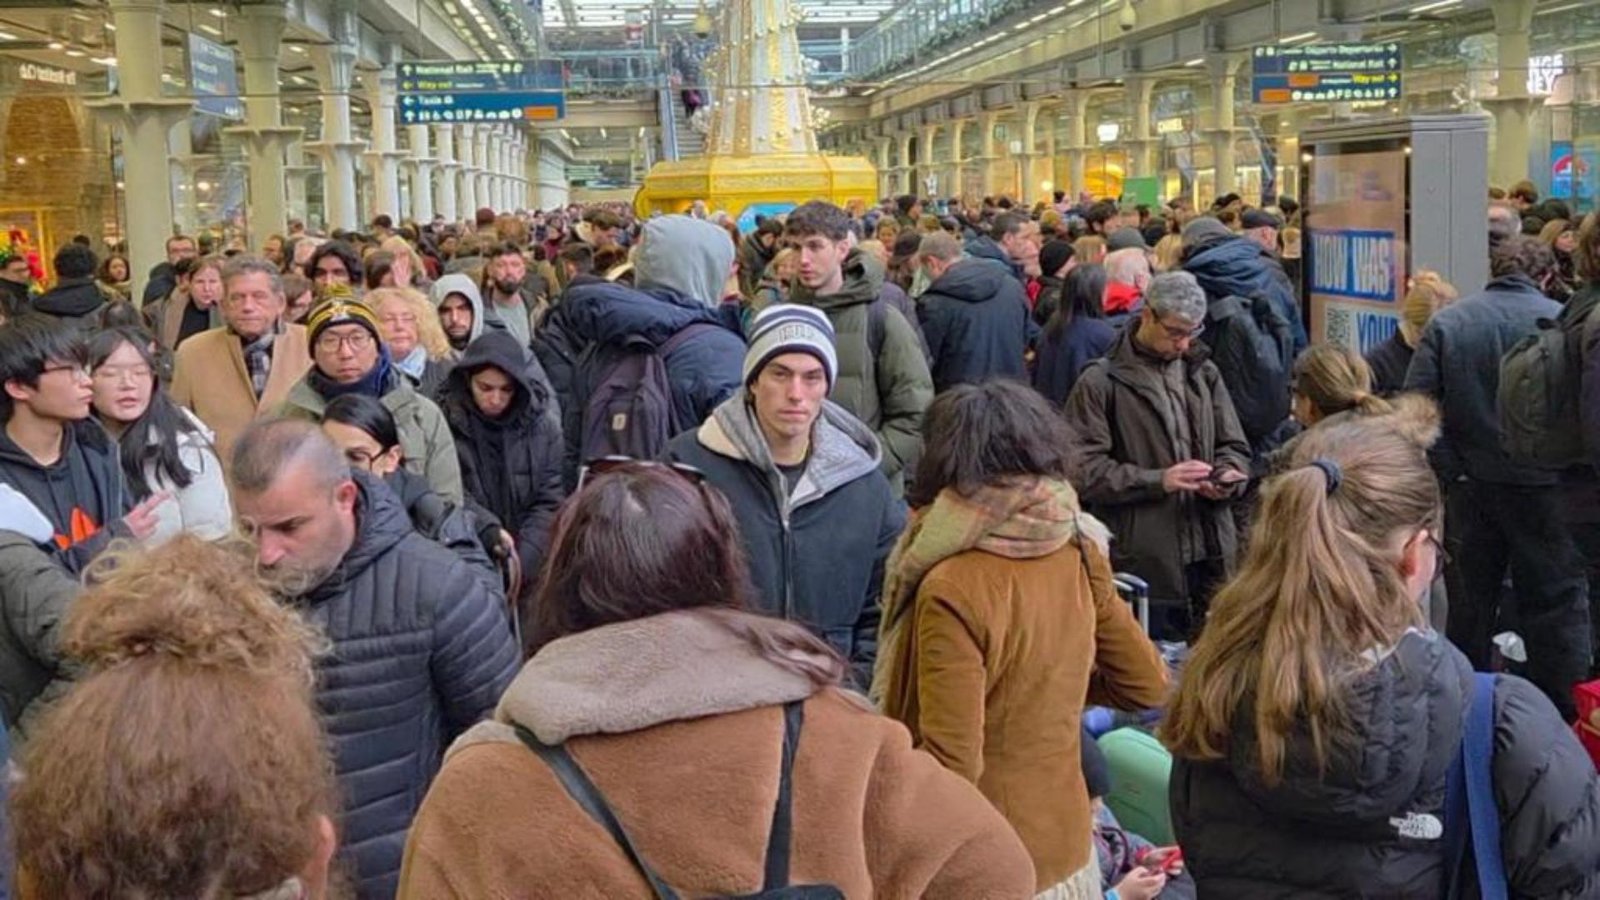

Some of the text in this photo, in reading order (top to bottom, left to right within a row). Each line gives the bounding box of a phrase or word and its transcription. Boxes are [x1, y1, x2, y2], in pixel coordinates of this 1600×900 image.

[416, 65, 454, 74] National
[456, 64, 473, 73] Rail
[1333, 60, 1366, 69] National
[1314, 235, 1390, 296] HOW WAS
